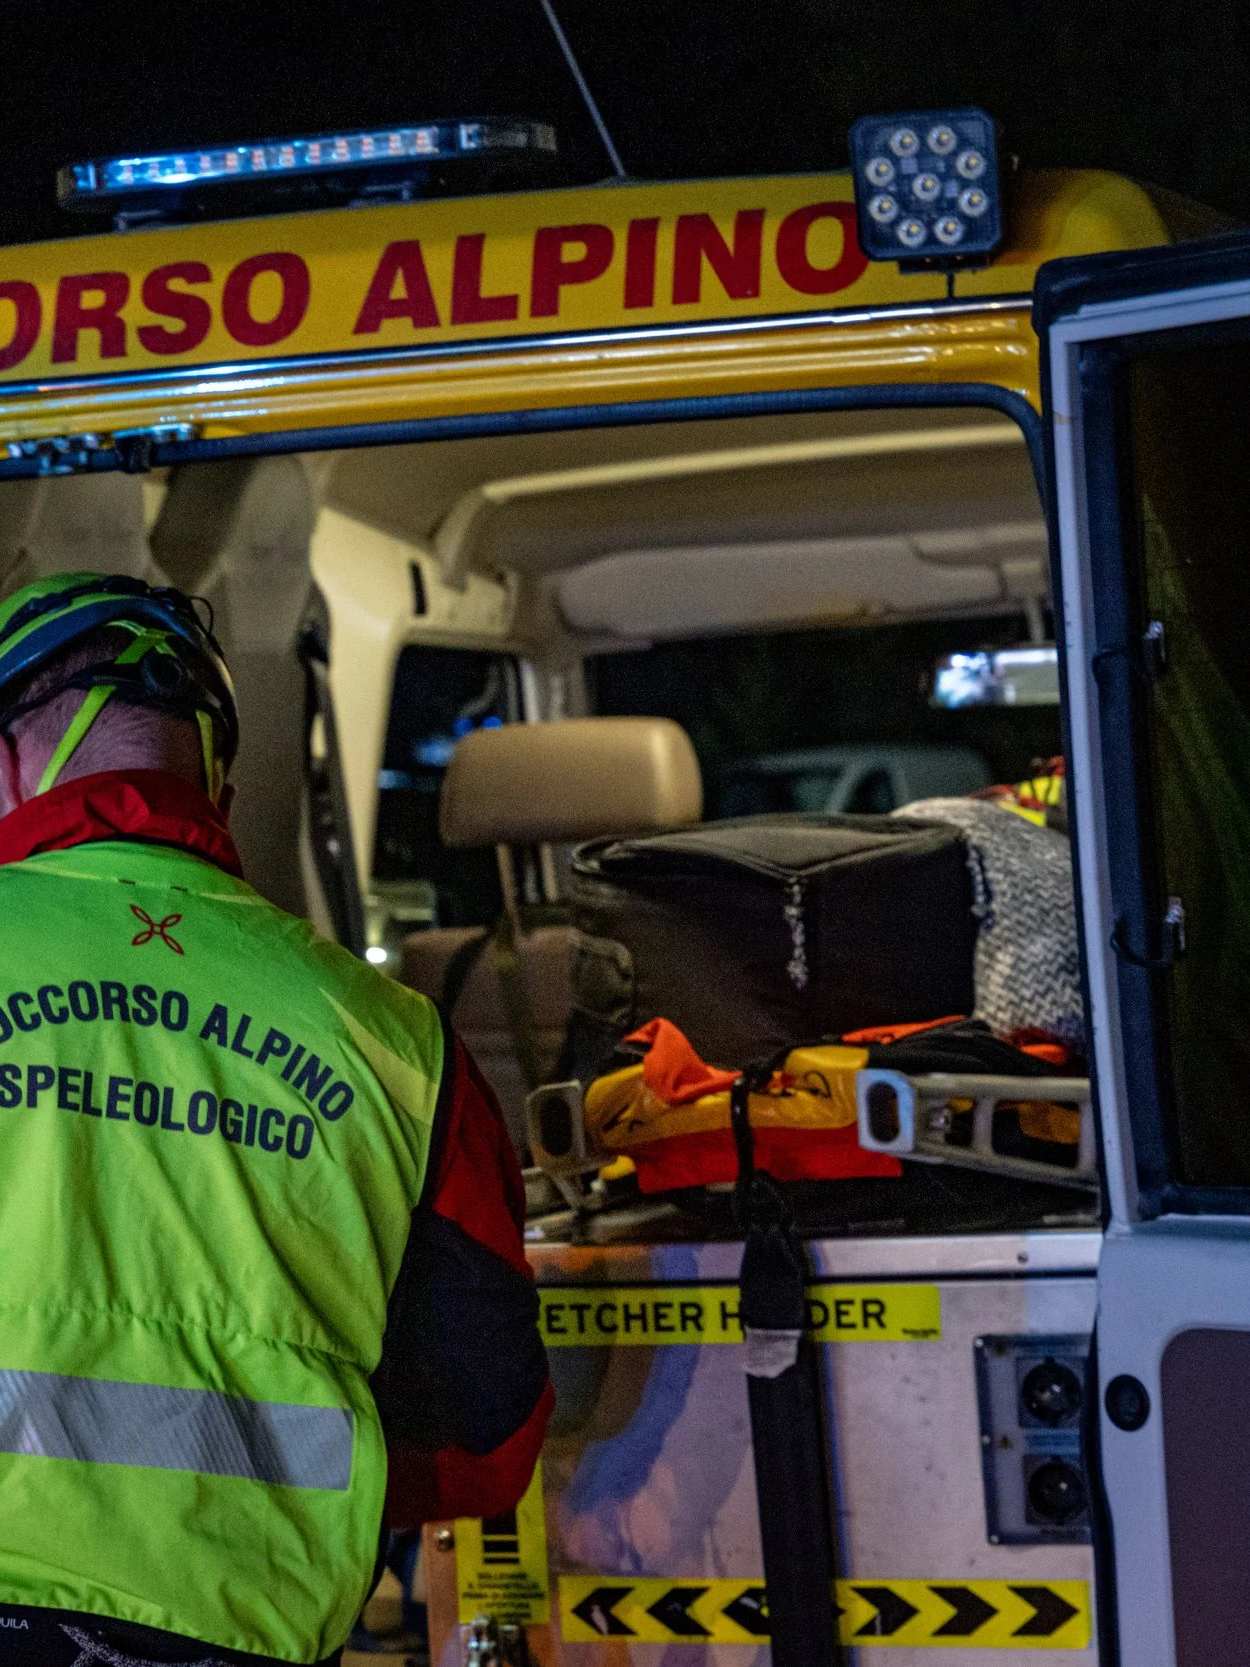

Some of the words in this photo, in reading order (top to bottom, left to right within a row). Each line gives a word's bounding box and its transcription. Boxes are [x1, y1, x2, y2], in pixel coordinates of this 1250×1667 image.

[352, 200, 871, 336] ALPINO
[199, 1002, 355, 1122] ALPINO
[545, 1302, 704, 1334] ETCHER
[720, 1298, 887, 1332] HDER
